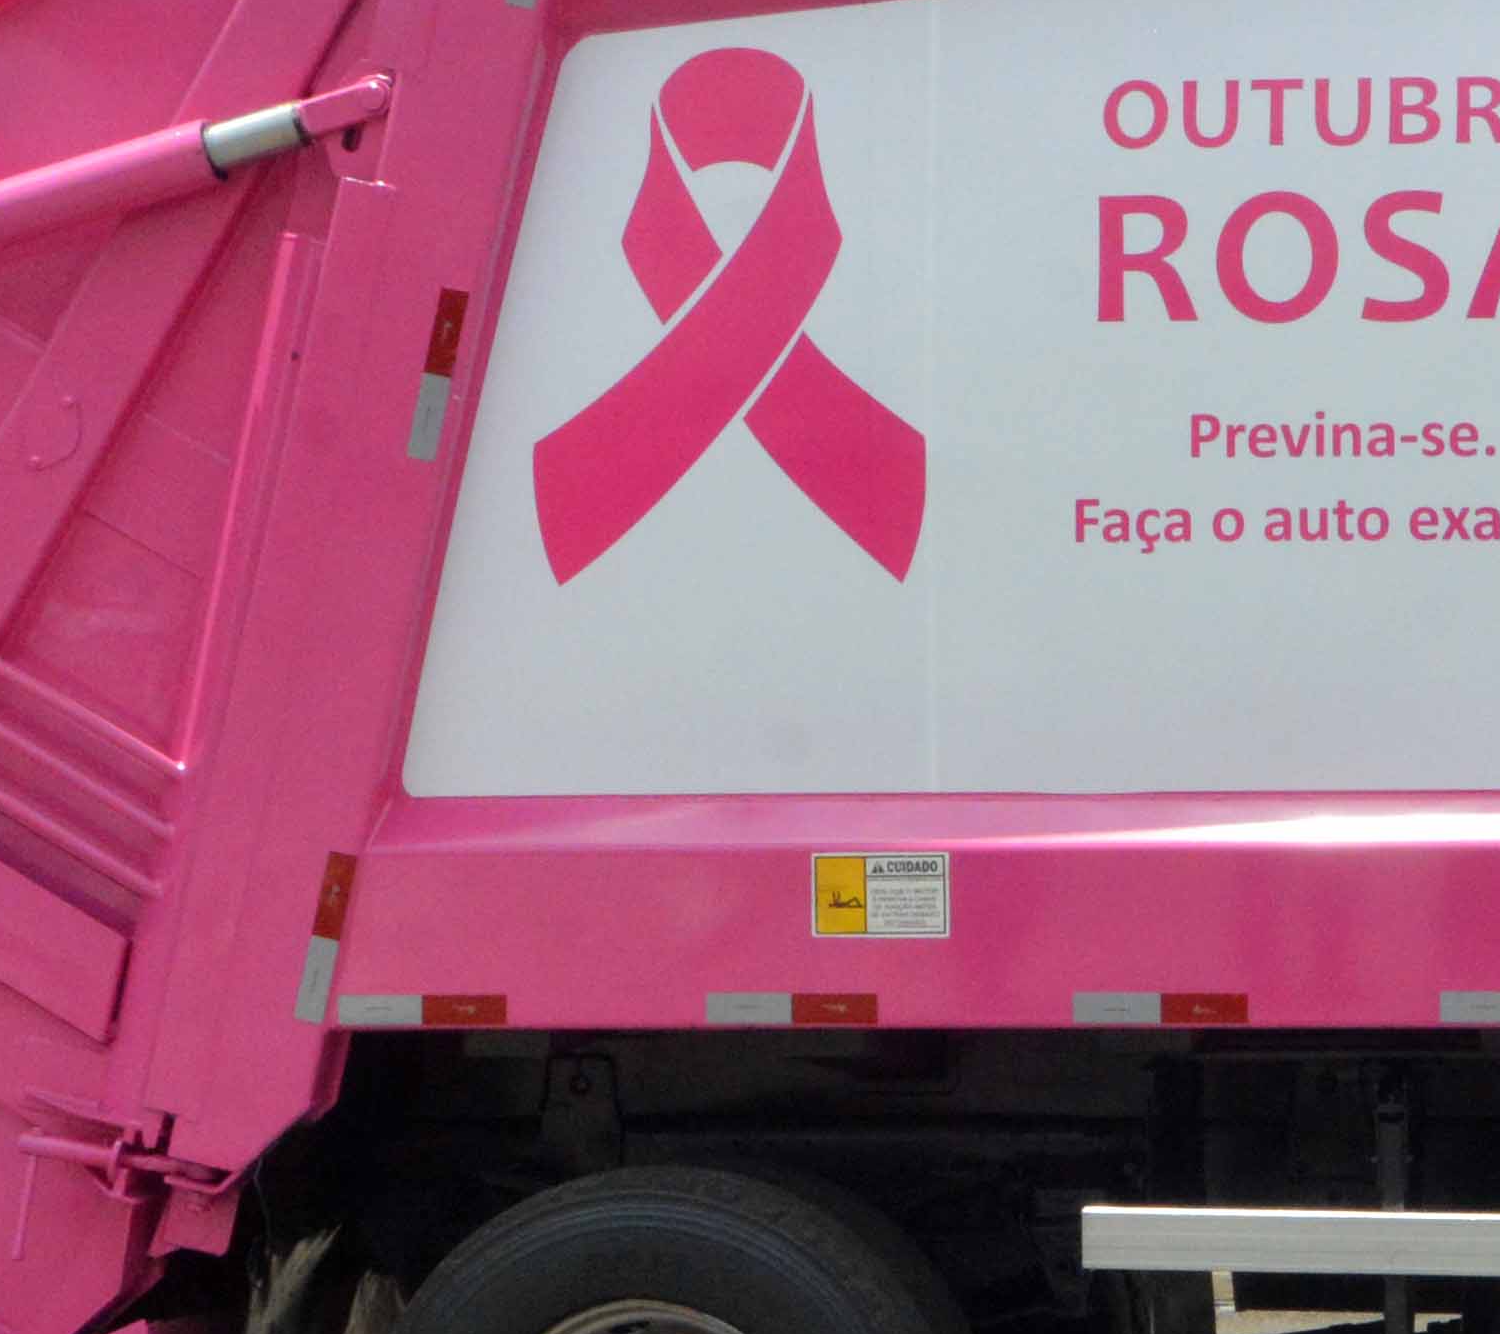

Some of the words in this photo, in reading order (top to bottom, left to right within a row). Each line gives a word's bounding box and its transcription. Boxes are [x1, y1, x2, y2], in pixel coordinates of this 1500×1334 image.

[1189, 410, 1497, 460] Previna-se.
[1074, 497, 1193, 555] Faça
[1211, 506, 1245, 543] o
[1264, 498, 1390, 543] auto
[886, 860, 939, 873] CUIDADO
